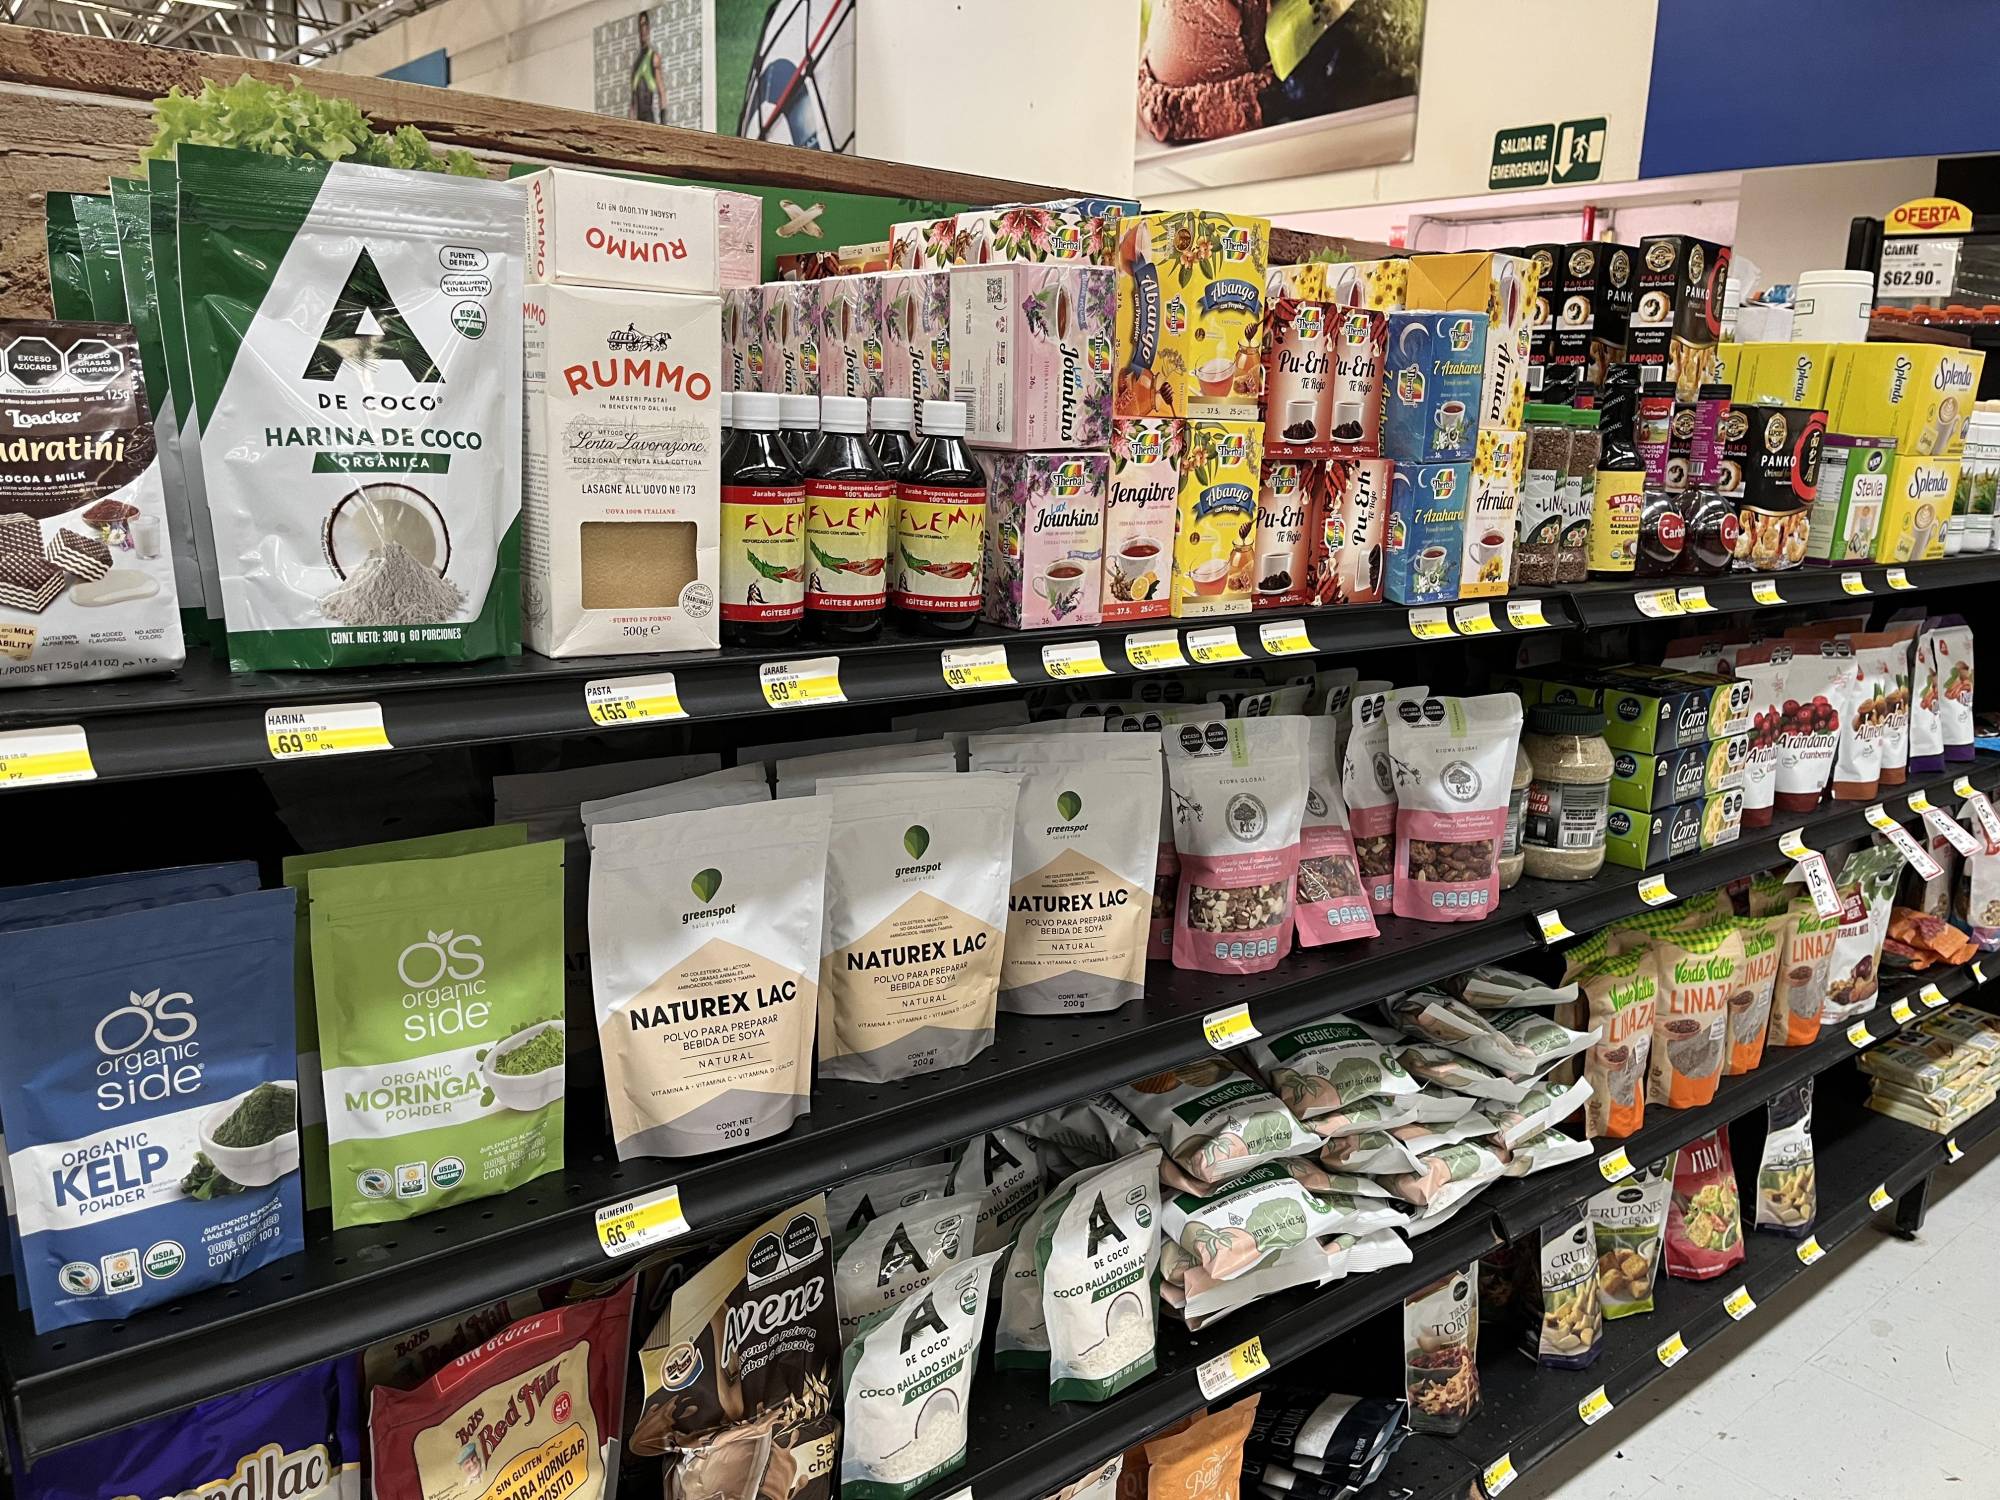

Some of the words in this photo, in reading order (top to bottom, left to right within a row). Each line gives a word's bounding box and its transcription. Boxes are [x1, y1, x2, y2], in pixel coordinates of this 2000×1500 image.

[1500, 136, 1532, 155] SALIDA
[1534, 134, 1547, 150] DE
[1491, 160, 1549, 180] EMERGENCIA
[1894, 206, 1960, 222] OFERTA
[533, 180, 545, 278] RUMMO
[585, 227, 687, 262] RUMMO
[1050, 237, 1082, 251] Therbal
[1223, 237, 1251, 252] Therbal
[1884, 244, 1919, 256] CARNE
[449, 252, 475, 260] FUENTE
[1641, 274, 1675, 283] PANKO
[1883, 270, 1934, 286] $62.90
[1211, 281, 1256, 302] Abango
[1686, 285, 1710, 300] PANKO
[302, 245, 446, 384] A
[1297, 318, 1322, 331] Therbal
[1346, 324, 1370, 337] Therbal
[13, 361, 58, 371] AZÚCARES
[18, 354, 51, 363] EXCESO
[78, 359, 111, 367] GRASAS
[1279, 349, 1329, 375] Pu-Erh
[1434, 360, 1440, 375] 7
[1441, 360, 1482, 377] Azahares
[1629, 354, 1664, 363] KAPORO
[71, 366, 119, 374] SATURADAS
[563, 358, 711, 401] RUMMO
[1794, 355, 1813, 402] Splenda
[1891, 356, 1912, 404] Splenda
[1935, 358, 1972, 391] Splenda
[1312, 378, 1326, 391] Rojo
[1490, 342, 1514, 421] Árnica
[106, 389, 129, 402] 125g
[319, 392, 348, 410] DE
[5, 408, 82, 429] Loacker
[265, 427, 375, 448] HARINA
[382, 427, 414, 448] DE
[421, 428, 482, 450] COCO
[570, 431, 616, 450] Lenta
[617, 432, 704, 457] Lavorazione
[338, 452, 430, 469] ORGÁNICA
[1131, 444, 1163, 457] Therbal
[1218, 444, 1246, 458] Therbal
[573, 457, 621, 465] ECCEZIONALE
[1761, 455, 1797, 468] PANKO
[56, 471, 86, 482] MILK
[1053, 474, 1085, 487] Therbal
[1432, 478, 1456, 490] Therbal
[1908, 466, 1948, 499] Splenda
[582, 484, 622, 494] LASAGNE
[625, 484, 667, 494] ALL'UOVO
[683, 485, 696, 495] 173
[816, 483, 837, 491] Jarabe
[1108, 481, 1175, 510] Jengibre
[1205, 485, 1250, 505] Abango
[1856, 477, 1883, 498] Stevia
[1352, 469, 1371, 547] Pu-Erh
[1477, 484, 1514, 513] Árnica
[1034, 508, 1099, 533] Jounkins
[1257, 506, 1305, 529] Pu-Erh
[819, 598, 850, 606] AGÍTESE
[851, 599, 870, 607] ANTES
[905, 597, 933, 607] AGÍTESE
[935, 599, 958, 608] ANTES
[331, 630, 356, 644] CONT.
[421, 626, 461, 641] PORCIONES
[623, 625, 649, 637] 500g
[37, 663, 52, 672] NET
[56, 661, 79, 670] 125g
[944, 655, 951, 663] TE
[763, 664, 788, 676] JARABE
[587, 686, 612, 696] PASTA
[769, 681, 789, 702] $69
[788, 681, 797, 689] 50
[267, 713, 306, 726] HARINA
[594, 702, 627, 722] $155
[626, 700, 636, 710] 00
[1680, 707, 1708, 730] Carr's
[273, 734, 303, 754] $69
[305, 732, 319, 743] 90
[1777, 733, 1835, 749] Arándano
[10, 772, 24, 780] PZ
[1676, 763, 1704, 785] Carr's
[1046, 823, 1089, 836] greenspot
[1672, 819, 1700, 842] Carr's
[895, 861, 942, 877] greenspot
[1809, 868, 1821, 889] 15
[1099, 888, 1129, 908] LAC
[682, 904, 736, 925] greenspot
[1838, 926, 1858, 938] TRAIL
[847, 940, 946, 971] NATUREX
[953, 932, 987, 957] LAC
[1675, 958, 1706, 985] Verde
[1707, 955, 1734, 980] Valle
[402, 979, 486, 1010] organic
[902, 994, 947, 1008] NATURAL
[1608, 982, 1633, 1012] Verde
[1633, 975, 1655, 1002] Valle
[630, 991, 751, 1031] NATUREX
[758, 980, 797, 1008] LAC
[404, 1001, 489, 1042] side
[663, 1030, 699, 1044] POLVO
[701, 1025, 729, 1036] PARA
[731, 1014, 778, 1032] PREPARAR
[1609, 1002, 1655, 1044] LINAZA
[683, 1037, 719, 1051] BEBIDA
[722, 1034, 736, 1045] DE
[738, 1028, 765, 1042] SOYA
[96, 1041, 199, 1078] organic
[698, 1051, 754, 1069] NATURAL
[381, 1064, 452, 1087] ORGANIC
[97, 1064, 201, 1111] side
[345, 1072, 482, 1112] MORINGA
[386, 1102, 452, 1122] POWDER
[724, 1128, 742, 1140] 200
[62, 1132, 148, 1168] ORGANIC
[53, 1145, 169, 1207] KELP
[79, 1187, 146, 1216] POWDER
[598, 1202, 634, 1221] ALIMENTO
[604, 1222, 627, 1248] $66
[625, 1220, 635, 1231] 90
[151, 1257, 179, 1271] ORGANIC
[153, 1249, 174, 1262] USDA
[1054, 1285, 1083, 1299] COCO
[1085, 1266, 1121, 1295] RALLADO
[1099, 1271, 1140, 1298] ORGÁNICO
[721, 1276, 825, 1369] Avena
[859, 1385, 895, 1400] COCO
[898, 1364, 940, 1392] RALLADO
[910, 1366, 958, 1400] ORGÁNICO
[536, 1438, 585, 1489] HORNEAR
[496, 1478, 512, 1495] SIN
[512, 1454, 542, 1482] GLUTEN
